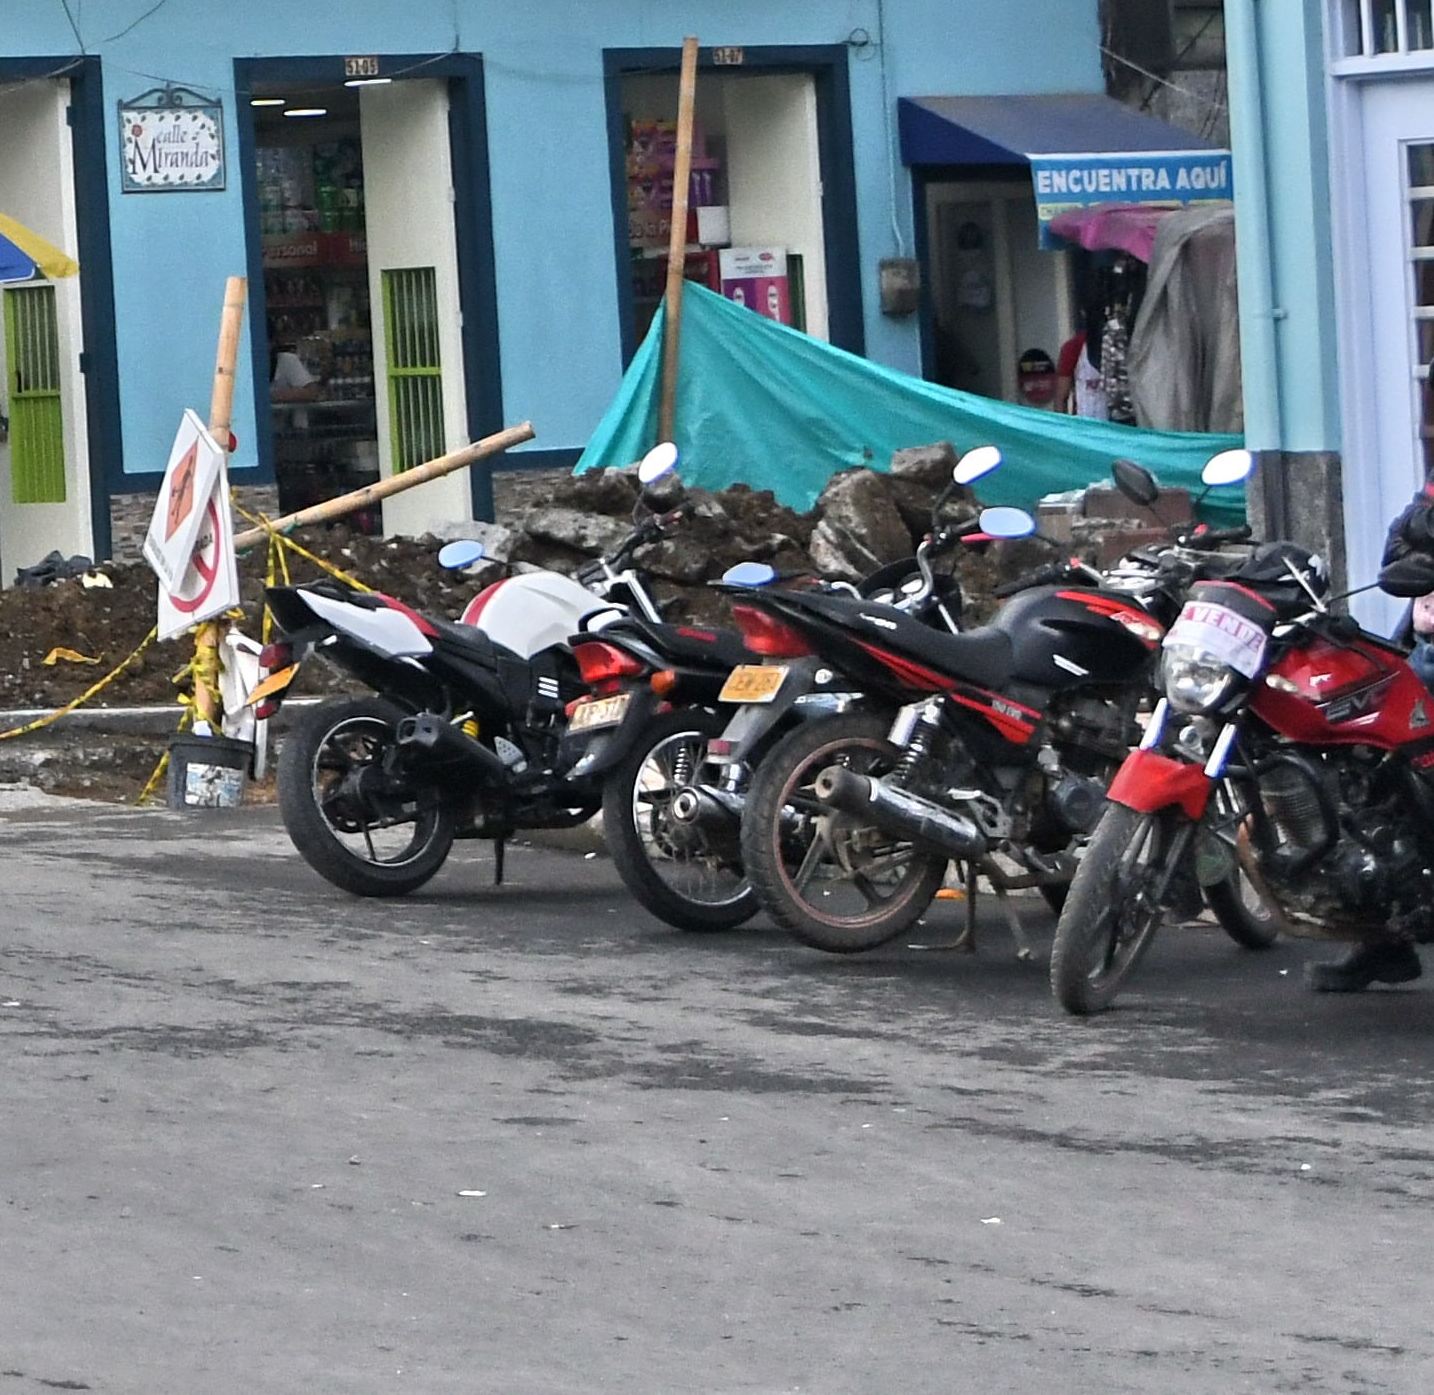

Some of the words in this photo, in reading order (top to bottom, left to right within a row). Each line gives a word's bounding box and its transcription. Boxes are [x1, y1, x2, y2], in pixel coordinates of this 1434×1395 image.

[156, 124, 188, 144] calle
[1037, 167, 1172, 194] ENCUENTRA
[1175, 160, 1228, 190] AQUÍ
[1194, 606, 1265, 653] VENDE
